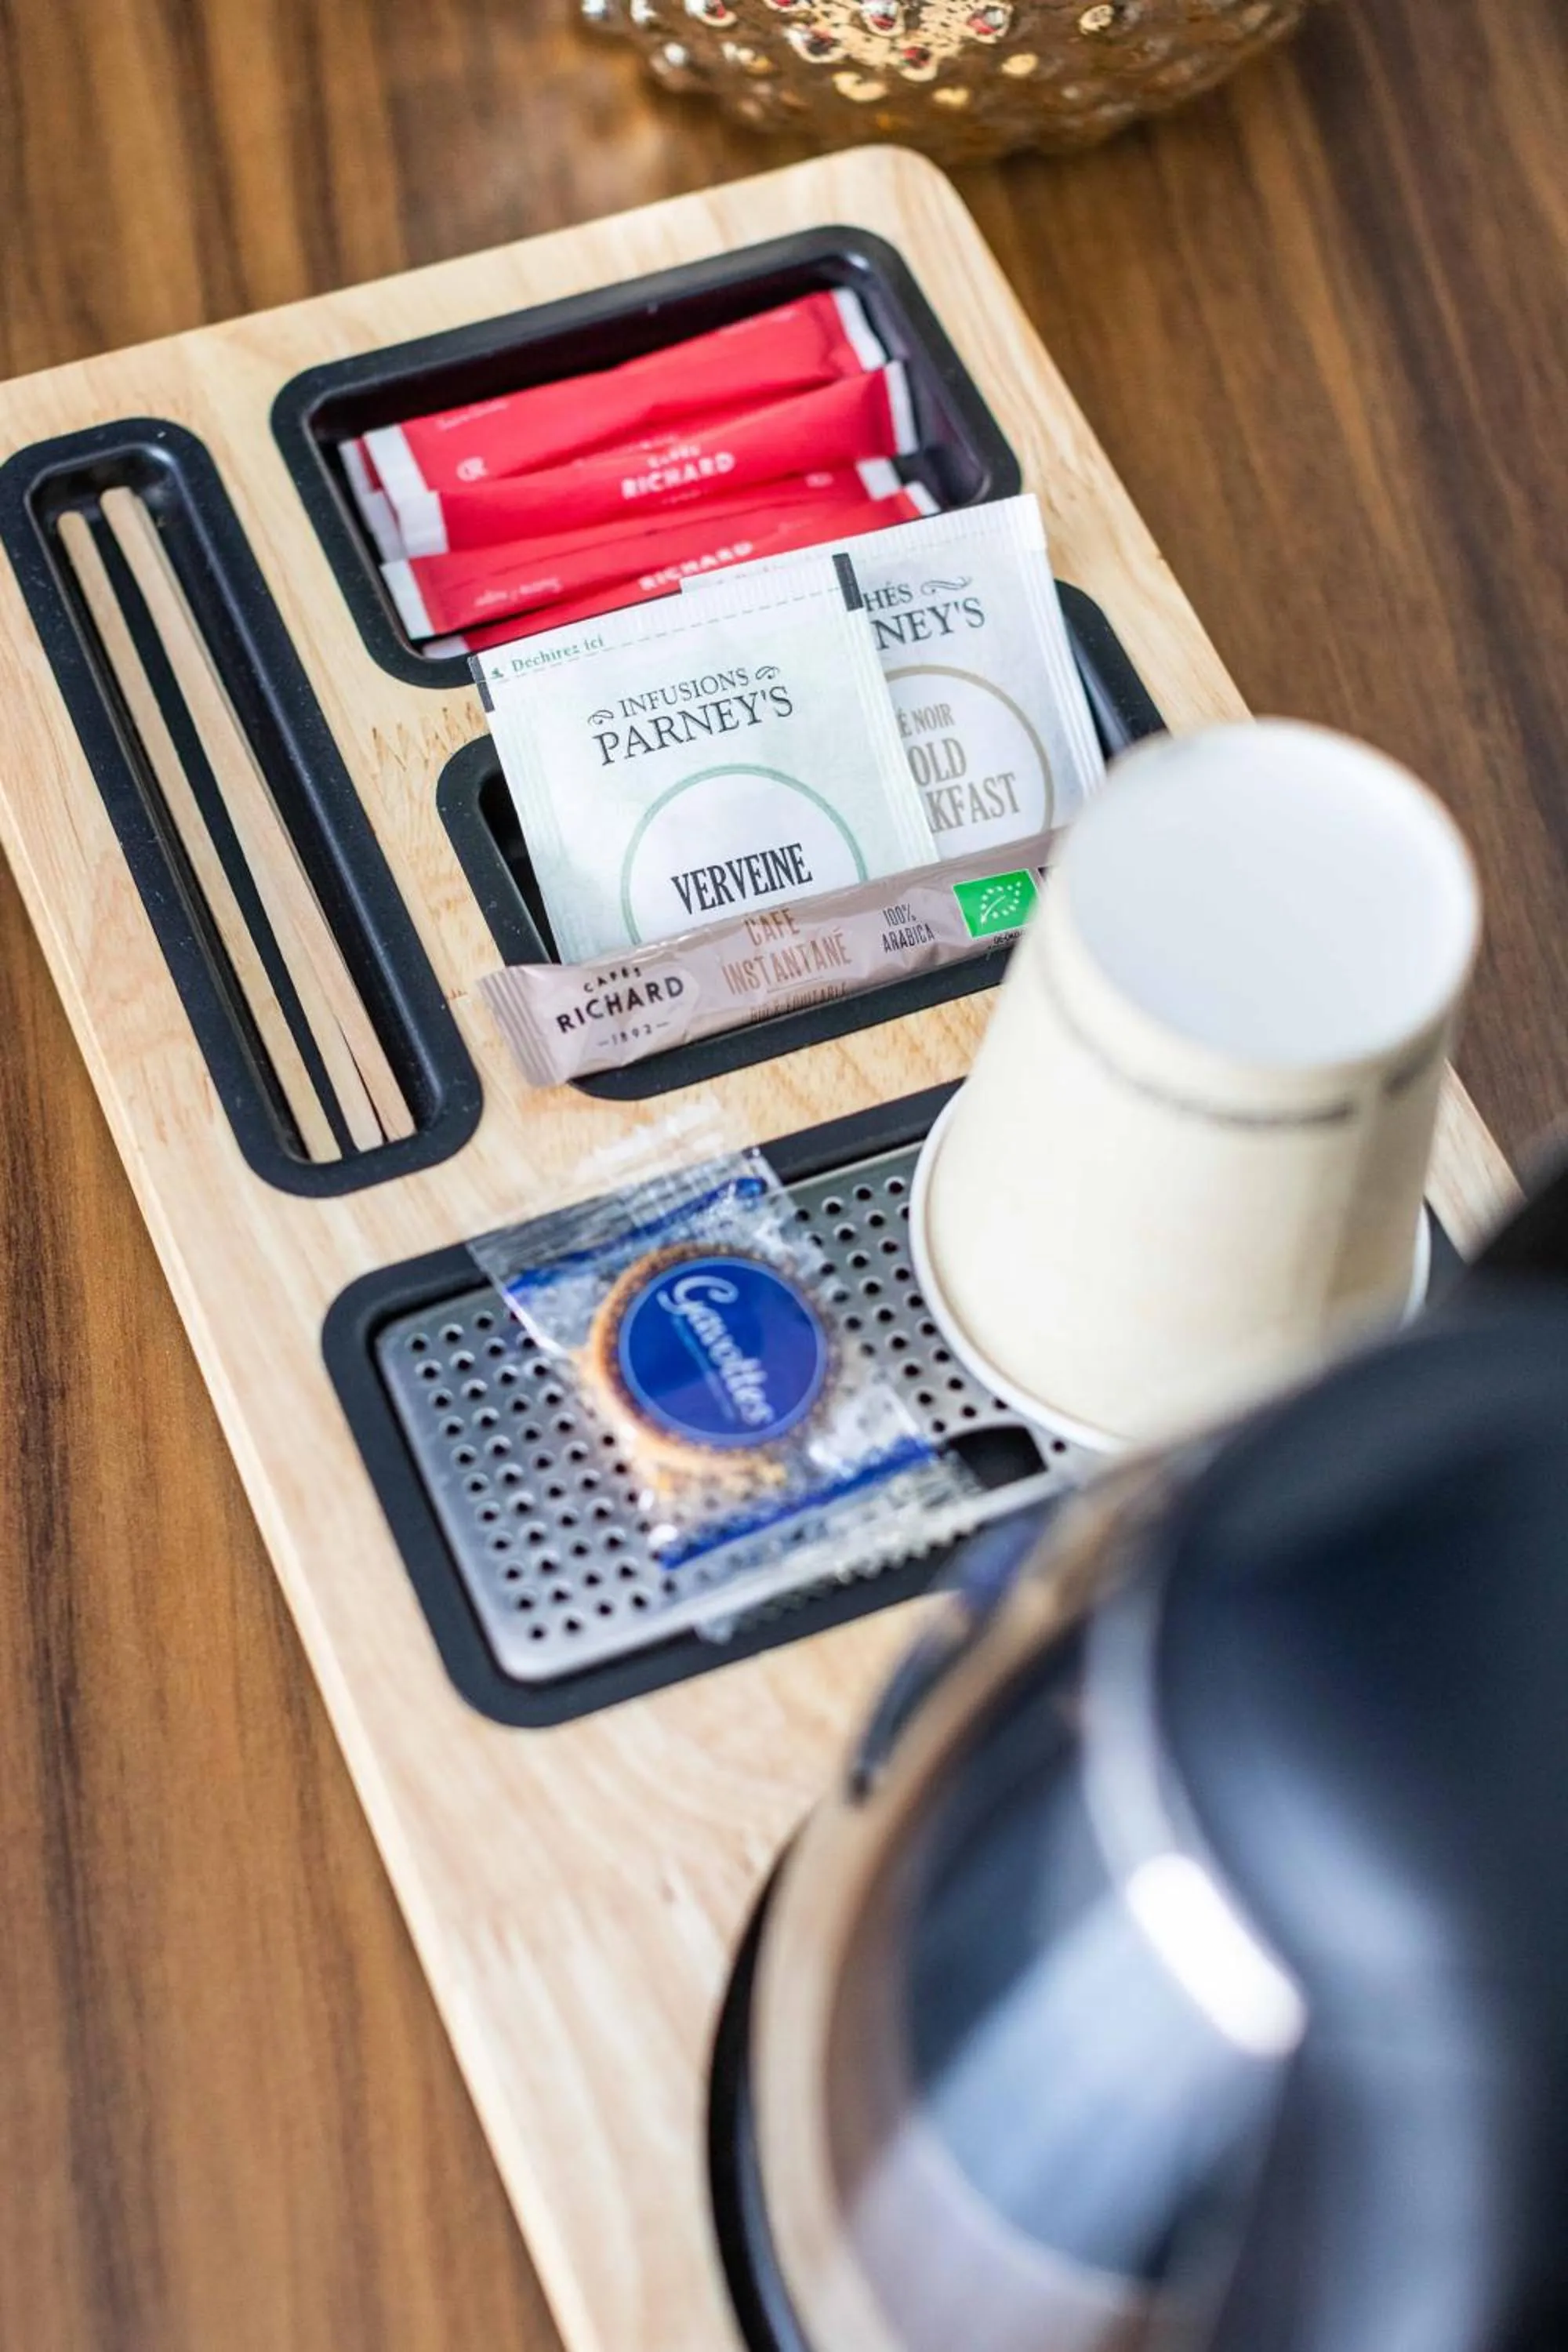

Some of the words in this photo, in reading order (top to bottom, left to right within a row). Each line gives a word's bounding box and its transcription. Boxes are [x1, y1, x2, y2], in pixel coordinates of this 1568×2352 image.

[863, 582, 913, 612] HÉS
[870, 597, 985, 651] NEY'S
[619, 667, 749, 718] INFUSIONS
[912, 702, 956, 735] NOIR
[592, 685, 793, 766] PARNEY'S
[925, 771, 1020, 833] KFAST
[670, 843, 813, 915] VERVEINE
[882, 902, 916, 927] 100%
[882, 923, 935, 953] ARABICA
[721, 926, 852, 996] INSTANTANÉ
[556, 976, 684, 1033] RICHARD
